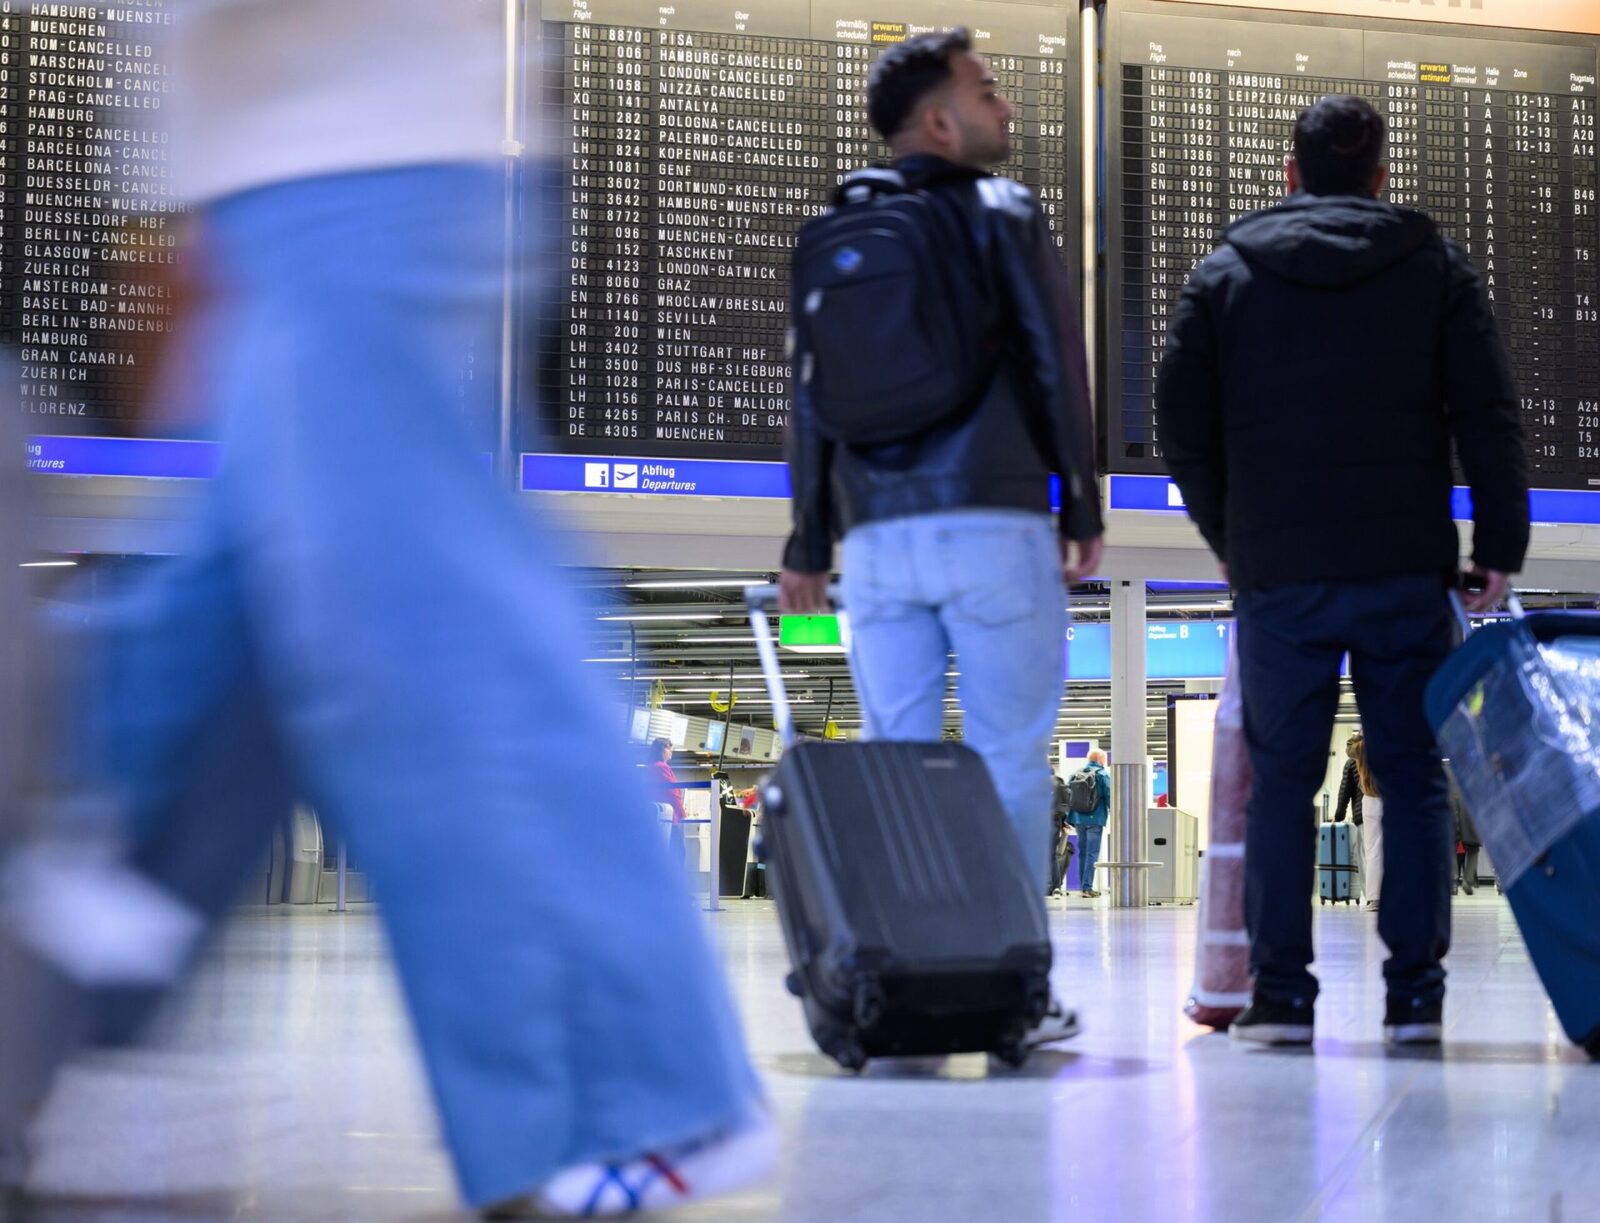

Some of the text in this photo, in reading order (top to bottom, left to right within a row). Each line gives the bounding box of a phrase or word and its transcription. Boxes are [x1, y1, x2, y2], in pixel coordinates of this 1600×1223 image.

[30, 19, 106, 37] MUENCHEN
[574, 28, 693, 46] EN 8870 PISA
[30, 37, 152, 58] ROM-CANCELLED
[573, 44, 1064, 73] LH 006 HAMBURG-CANCELLED B13
[617, 64, 795, 85] 900 LONDON-CANCELLED
[610, 80, 786, 101] 1058 NIZZA-CANCELLED
[1150, 69, 1586, 111] LH 008 HAMBURG 12-13 A1
[28, 89, 160, 109] PRAG-CANCELLED
[573, 94, 718, 113] XQ 141 ANTALYA
[1150, 85, 1594, 126] LH 152 12-13 A13
[28, 106, 94, 122] HAMBURG
[1150, 101, 1594, 141] LH 1458 LJUBLJANA 12-13 A20
[28, 123, 169, 144] PARIS-CANCELLED
[617, 113, 1064, 137] 282 BOLOGNA-CANCELLED B47
[617, 130, 803, 151] 322 PALERMO-CANCELLED
[1150, 116, 1595, 156] DX 192 LINZ 12-13 A14
[1183, 134, 1212, 146] 1362
[616, 146, 820, 168] 824 KOPENHAGE-CANCELLED
[1183, 150, 1212, 161] 1386
[572, 160, 692, 177] LX 1081 GENF
[572, 176, 1064, 200] LH 3602 DORTMUND-KOELN HBF A15
[1151, 163, 1595, 201] SQ 026 NEW YORK B46
[607, 195, 640, 207] 3642
[1151, 179, 1588, 216] EN 8910 B1
[1190, 197, 1213, 208] 814
[25, 210, 167, 229] DUESSELDORF HBF
[572, 209, 751, 230] EN 8772 LONDON-CITY
[1183, 212, 1213, 224] 1086
[24, 227, 176, 247] BERLIN-CANCELLED
[616, 228, 640, 240] 096
[1151, 226, 1213, 239] LH 3450
[571, 242, 734, 261] C6 152 TASCHKENT
[1151, 241, 1213, 255] LH 178
[1576, 249, 1590, 261] T5
[24, 262, 90, 277] ZUERICH
[571, 259, 777, 280] DE 4123 LONDON-GATWICK
[571, 275, 691, 292] EN 8060 GRAZ
[23, 297, 69, 311] BASEL
[571, 292, 785, 313] EN 8766 WROCLAW/BRESLAU
[1576, 295, 1590, 307] T4
[607, 310, 717, 326] 1140 SEVILLA
[1576, 310, 1598, 322] B13
[22, 331, 88, 346] HAMBURG
[570, 325, 691, 341] OR 200 WIEN
[21, 349, 135, 365] GRAN CANARIA
[570, 341, 768, 362] LH 3402 STUTTGART HBF
[20, 366, 87, 381] ZUERICH
[606, 360, 793, 380] 3500 DUS HBF-SIEGBURG
[20, 383, 58, 397] WIEN
[607, 376, 784, 396] 1028 PARIS-CANCELLED
[20, 401, 86, 416] FLORENZ
[570, 391, 725, 409] LH 1156 PALMA DE
[1577, 401, 1599, 413] A24
[569, 407, 759, 427] DE 4265 PARIS CH. DE
[1578, 416, 1599, 429] Z20
[569, 424, 724, 442] DE 4305 MUENCHEN
[1579, 431, 1592, 443] T5
[1579, 447, 1599, 459] B24
[641, 464, 676, 479] Abflug
[641, 479, 696, 491] Departures
[1066, 627, 1076, 642] C
[1179, 624, 1189, 639] B
